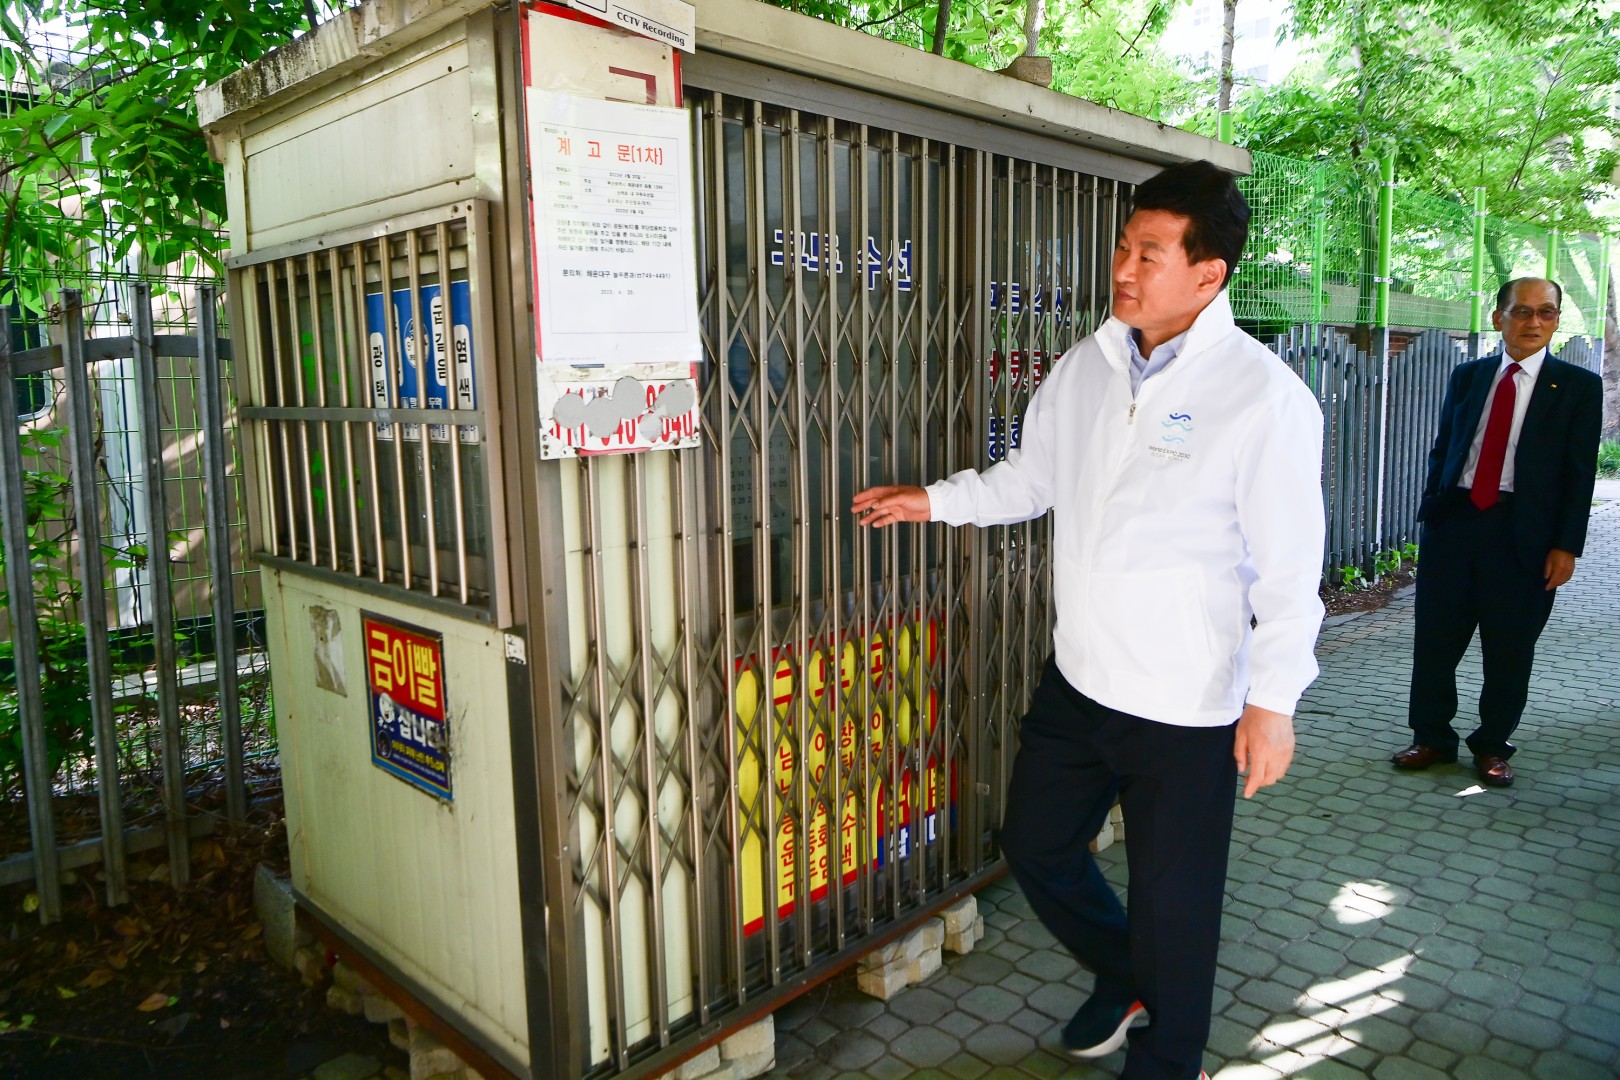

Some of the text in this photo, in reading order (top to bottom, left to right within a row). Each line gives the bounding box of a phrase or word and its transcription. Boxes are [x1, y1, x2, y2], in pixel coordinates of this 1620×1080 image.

[616, 11, 685, 47] CCTV Recording
[557, 136, 571, 156] 계
[587, 140, 601, 158] 고
[586, 269, 611, 279] 해운대구
[370, 629, 438, 709] 금이빨
